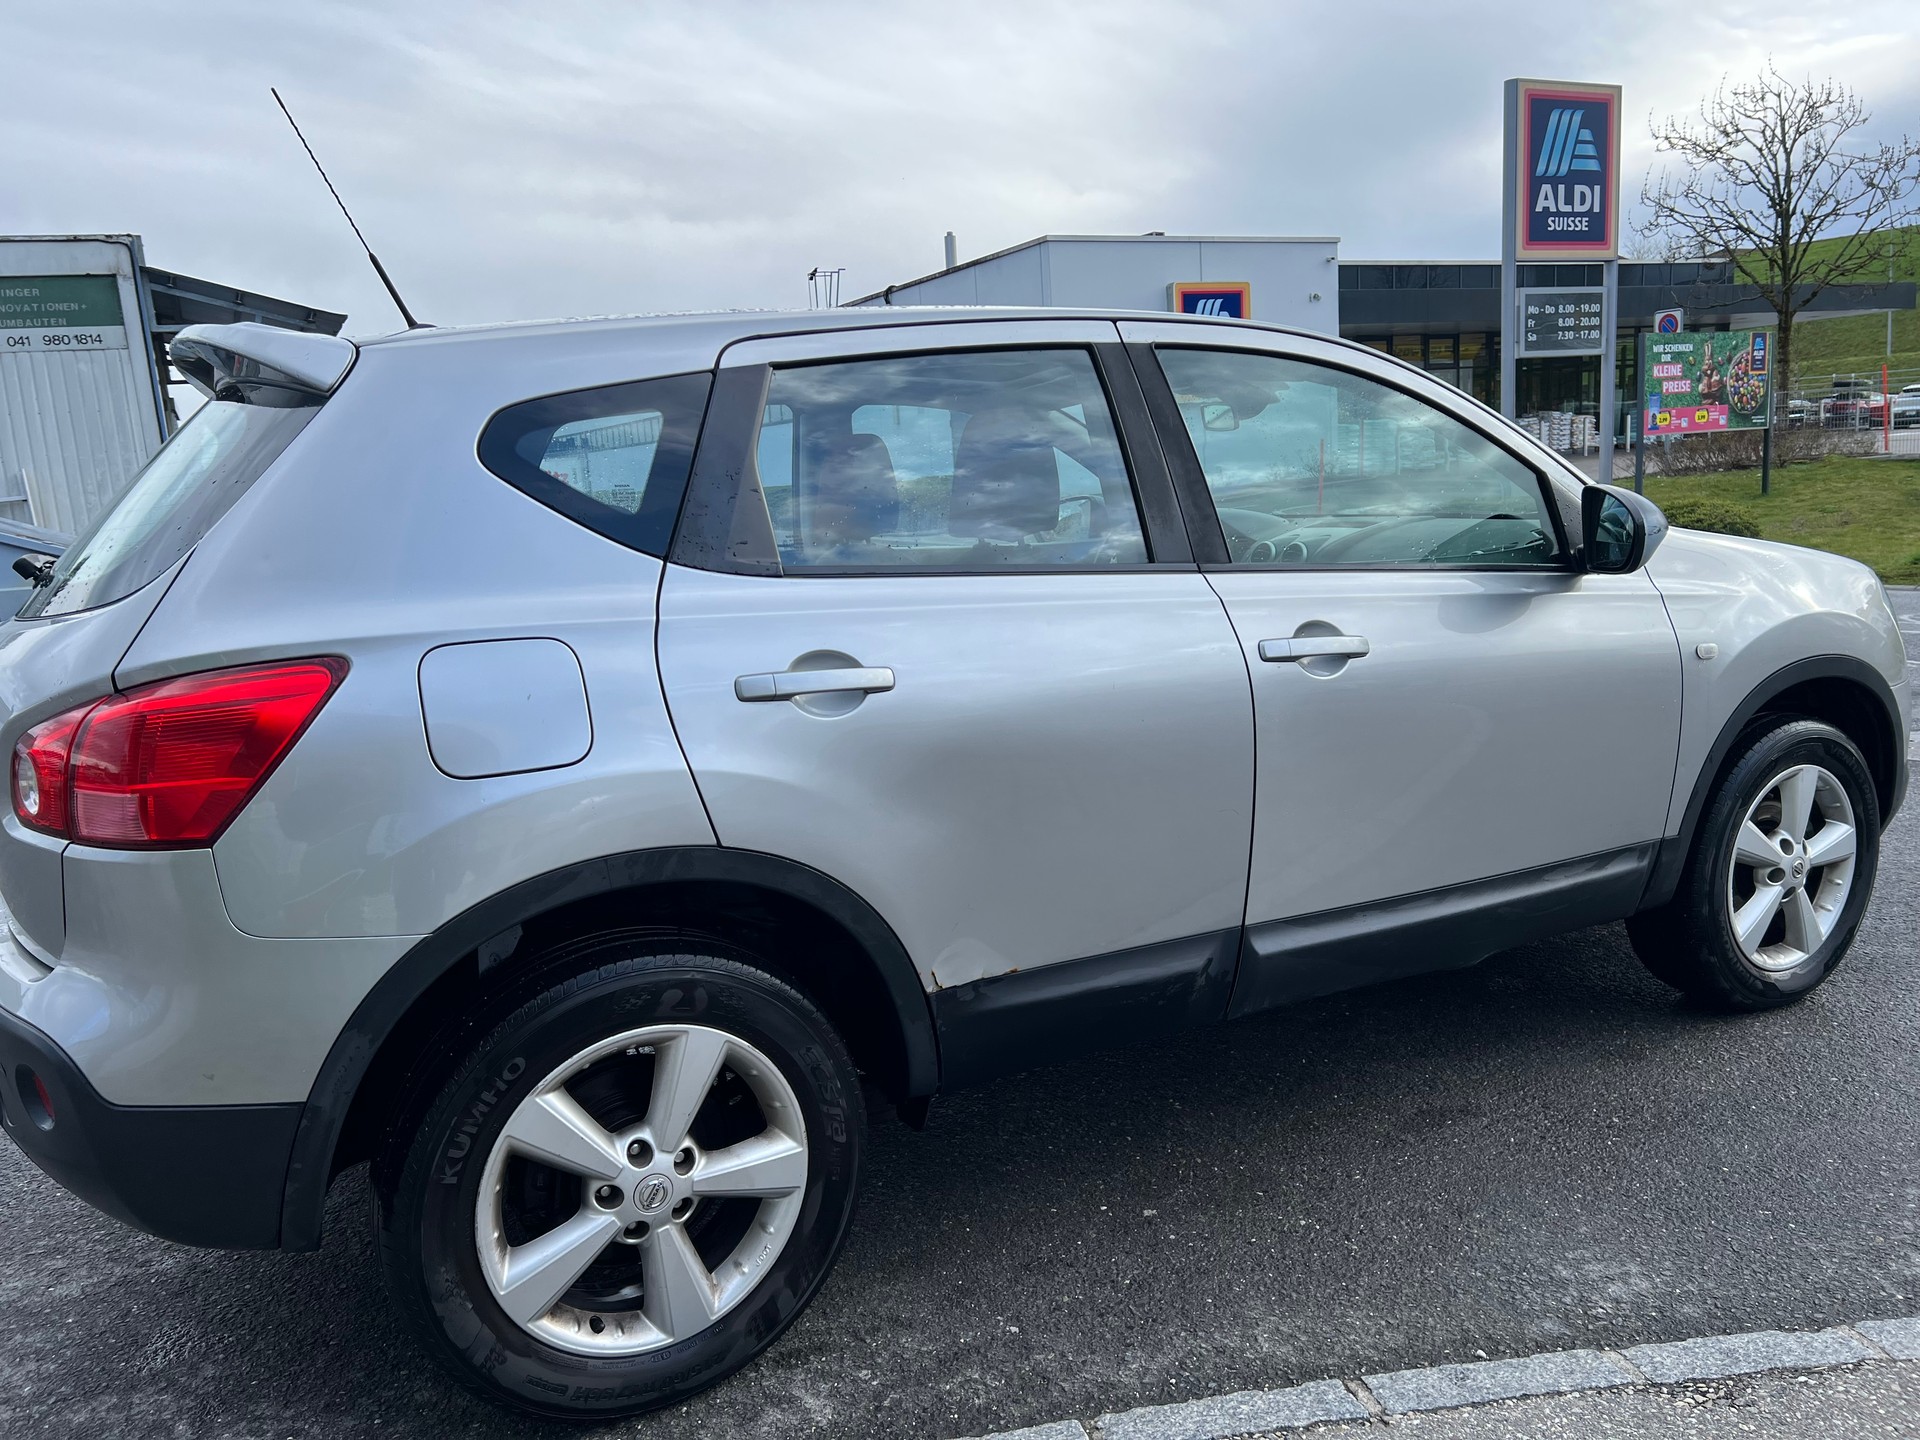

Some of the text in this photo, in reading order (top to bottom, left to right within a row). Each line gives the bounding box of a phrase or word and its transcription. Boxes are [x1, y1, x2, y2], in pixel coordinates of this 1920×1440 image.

[1535, 184, 1600, 212] ALDI
[1547, 217, 1589, 231] SUISSE
[1, 288, 40, 297] INGER
[1528, 305, 1539, 314] Mo
[1545, 305, 1555, 314] Do
[1558, 304, 1575, 313] 8.00
[1581, 304, 1600, 313] 19.00
[0, 318, 67, 328] UMBAUTEN
[1528, 319, 1536, 328] Fr
[1558, 318, 1575, 327] 8.00
[1580, 317, 1600, 326] 20.00
[1527, 332, 1537, 341] Sa
[1557, 331, 1574, 340] 7.30
[1580, 330, 1600, 339] 17.00
[6, 336, 31, 347] 041
[1653, 344, 1694, 353] WIR SCHENKEN
[1661, 354, 1671, 362] DIR
[1653, 365, 1682, 377] KLEINE
[1662, 381, 1691, 392] PREISE
[439, 1056, 526, 1184] KUMHO
